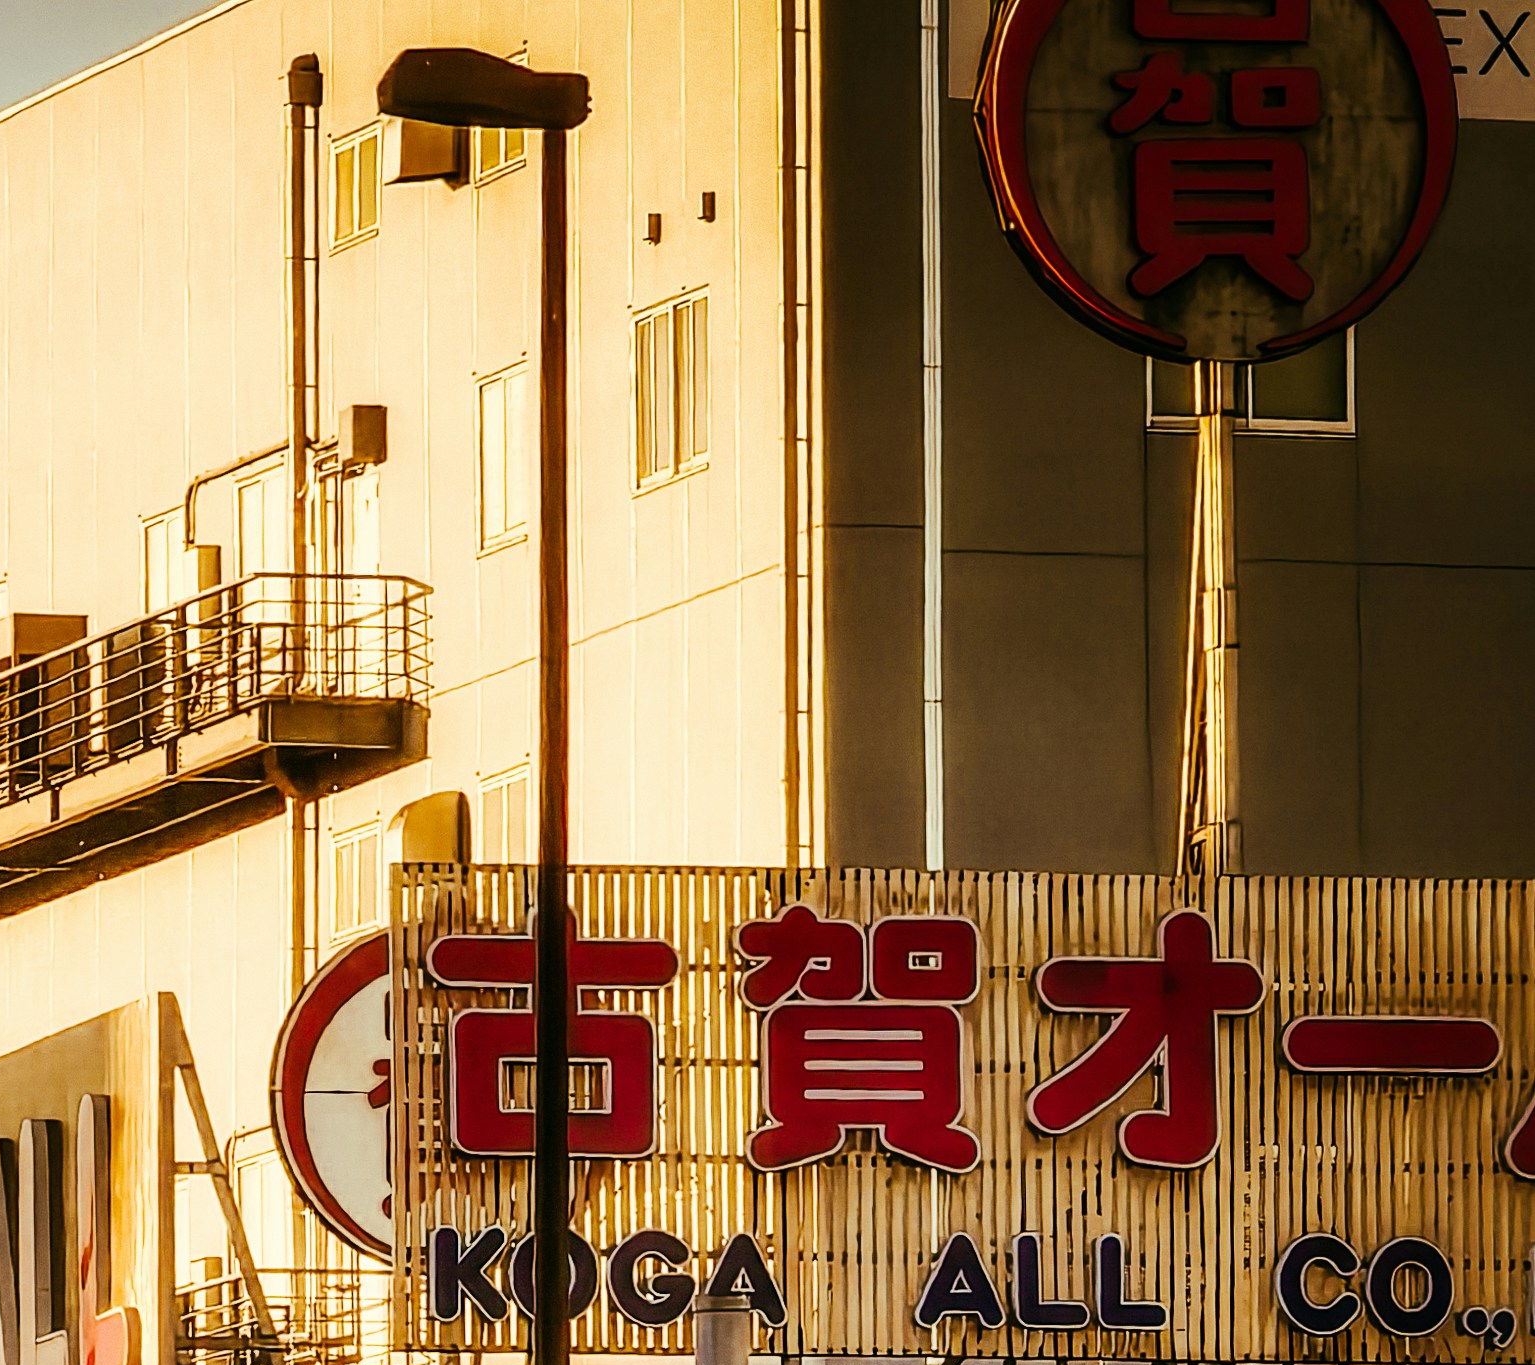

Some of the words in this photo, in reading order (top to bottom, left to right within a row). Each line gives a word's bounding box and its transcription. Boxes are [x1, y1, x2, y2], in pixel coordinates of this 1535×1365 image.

[1108, 0, 1323, 302] 賀
[427, 900, 1535, 1184] 古賀オー
[429, 1223, 788, 1328] KOGA
[915, 1229, 1169, 1333] ALL
